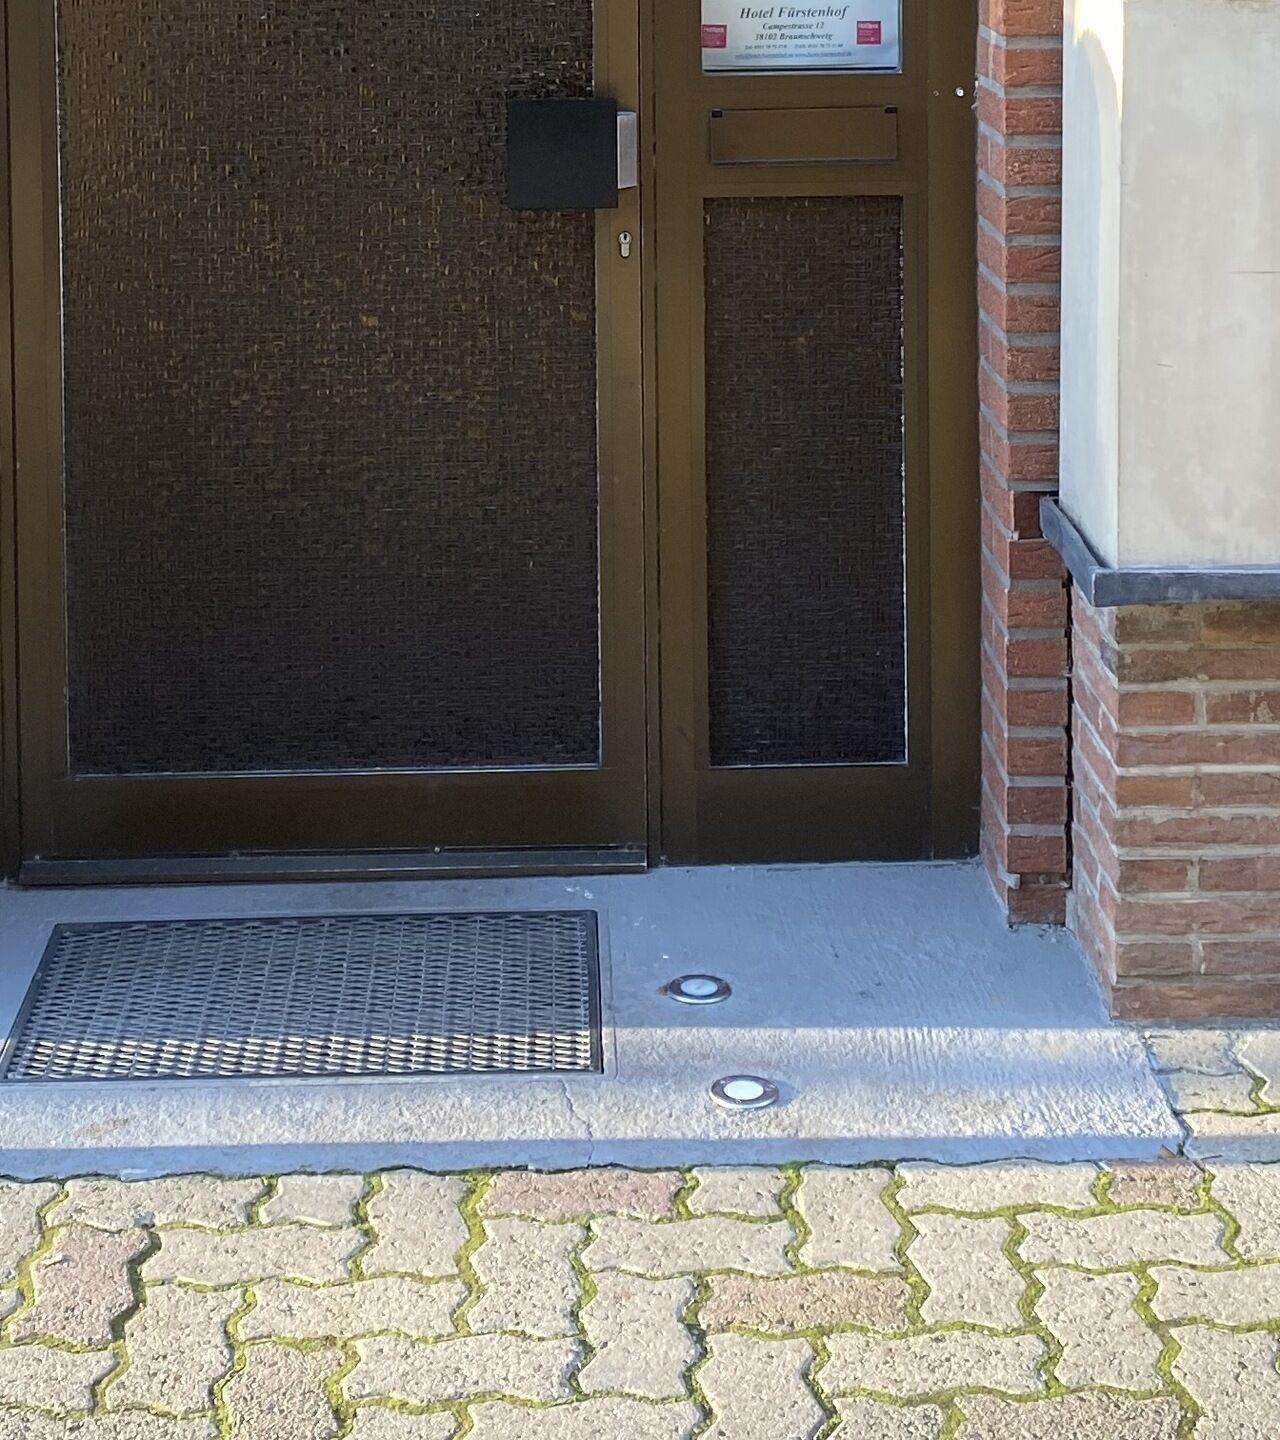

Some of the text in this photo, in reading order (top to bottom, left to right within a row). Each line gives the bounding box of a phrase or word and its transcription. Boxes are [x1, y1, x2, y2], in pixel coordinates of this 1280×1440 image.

[739, 5, 850, 20] Hotel Fürstenhof
[762, 22, 814, 31] Campestrasse
[754, 31, 833, 42] 38102 Braunschweig
